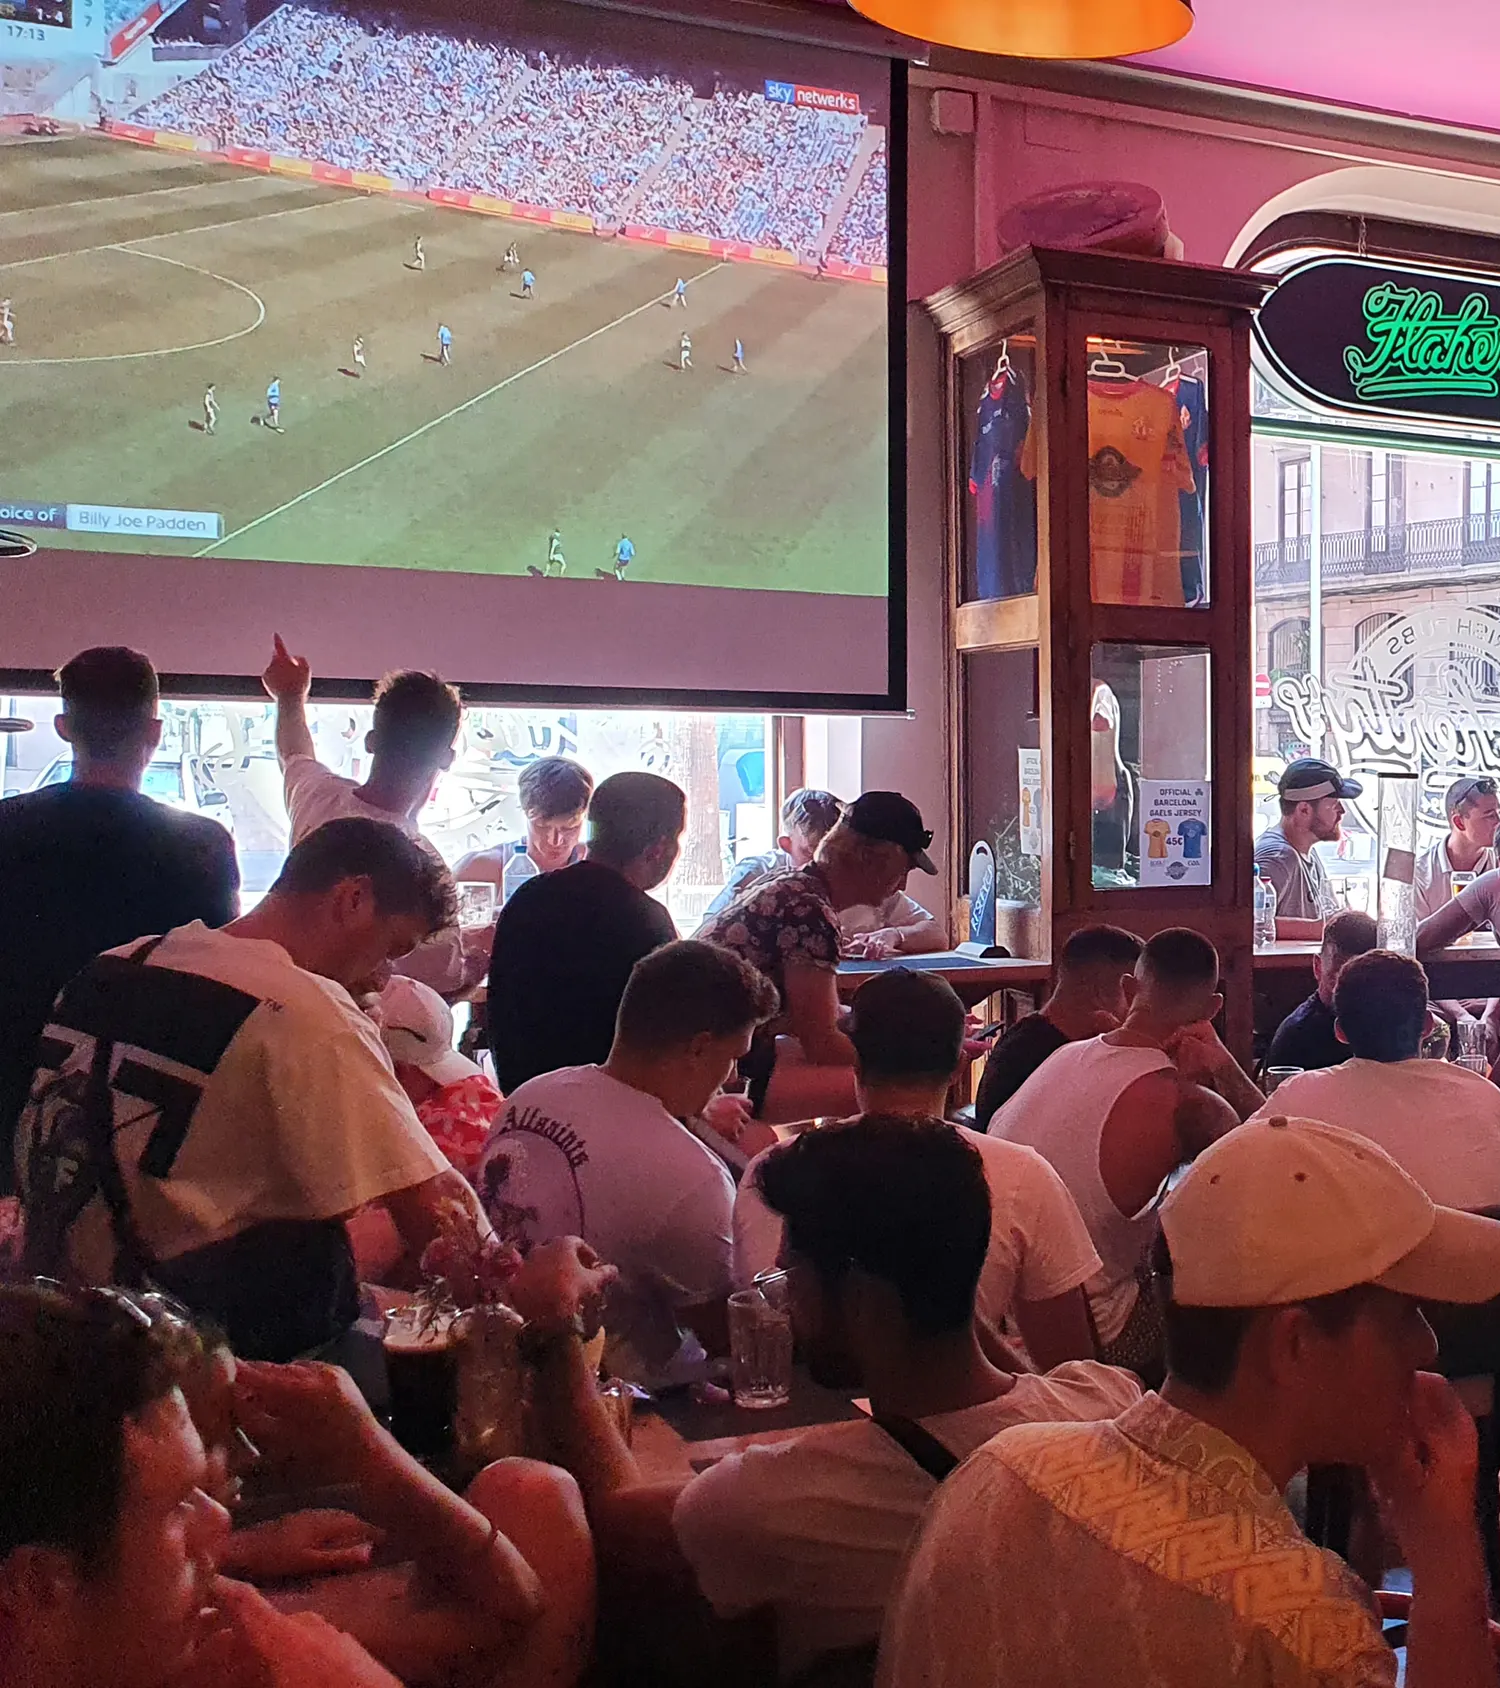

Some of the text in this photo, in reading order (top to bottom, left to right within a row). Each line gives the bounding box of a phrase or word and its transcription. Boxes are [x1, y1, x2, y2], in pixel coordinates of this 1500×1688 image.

[7, 25, 46, 41] 17:13
[768, 83, 792, 103] sky
[37, 507, 58, 522] of
[79, 511, 111, 528] Billy
[116, 513, 142, 528] Joe
[147, 516, 206, 532] Padden
[1160, 788, 1192, 796] OFFICIAL
[1154, 799, 1197, 807] BARCELONA
[1149, 809, 1202, 817] GAELS JERSEY
